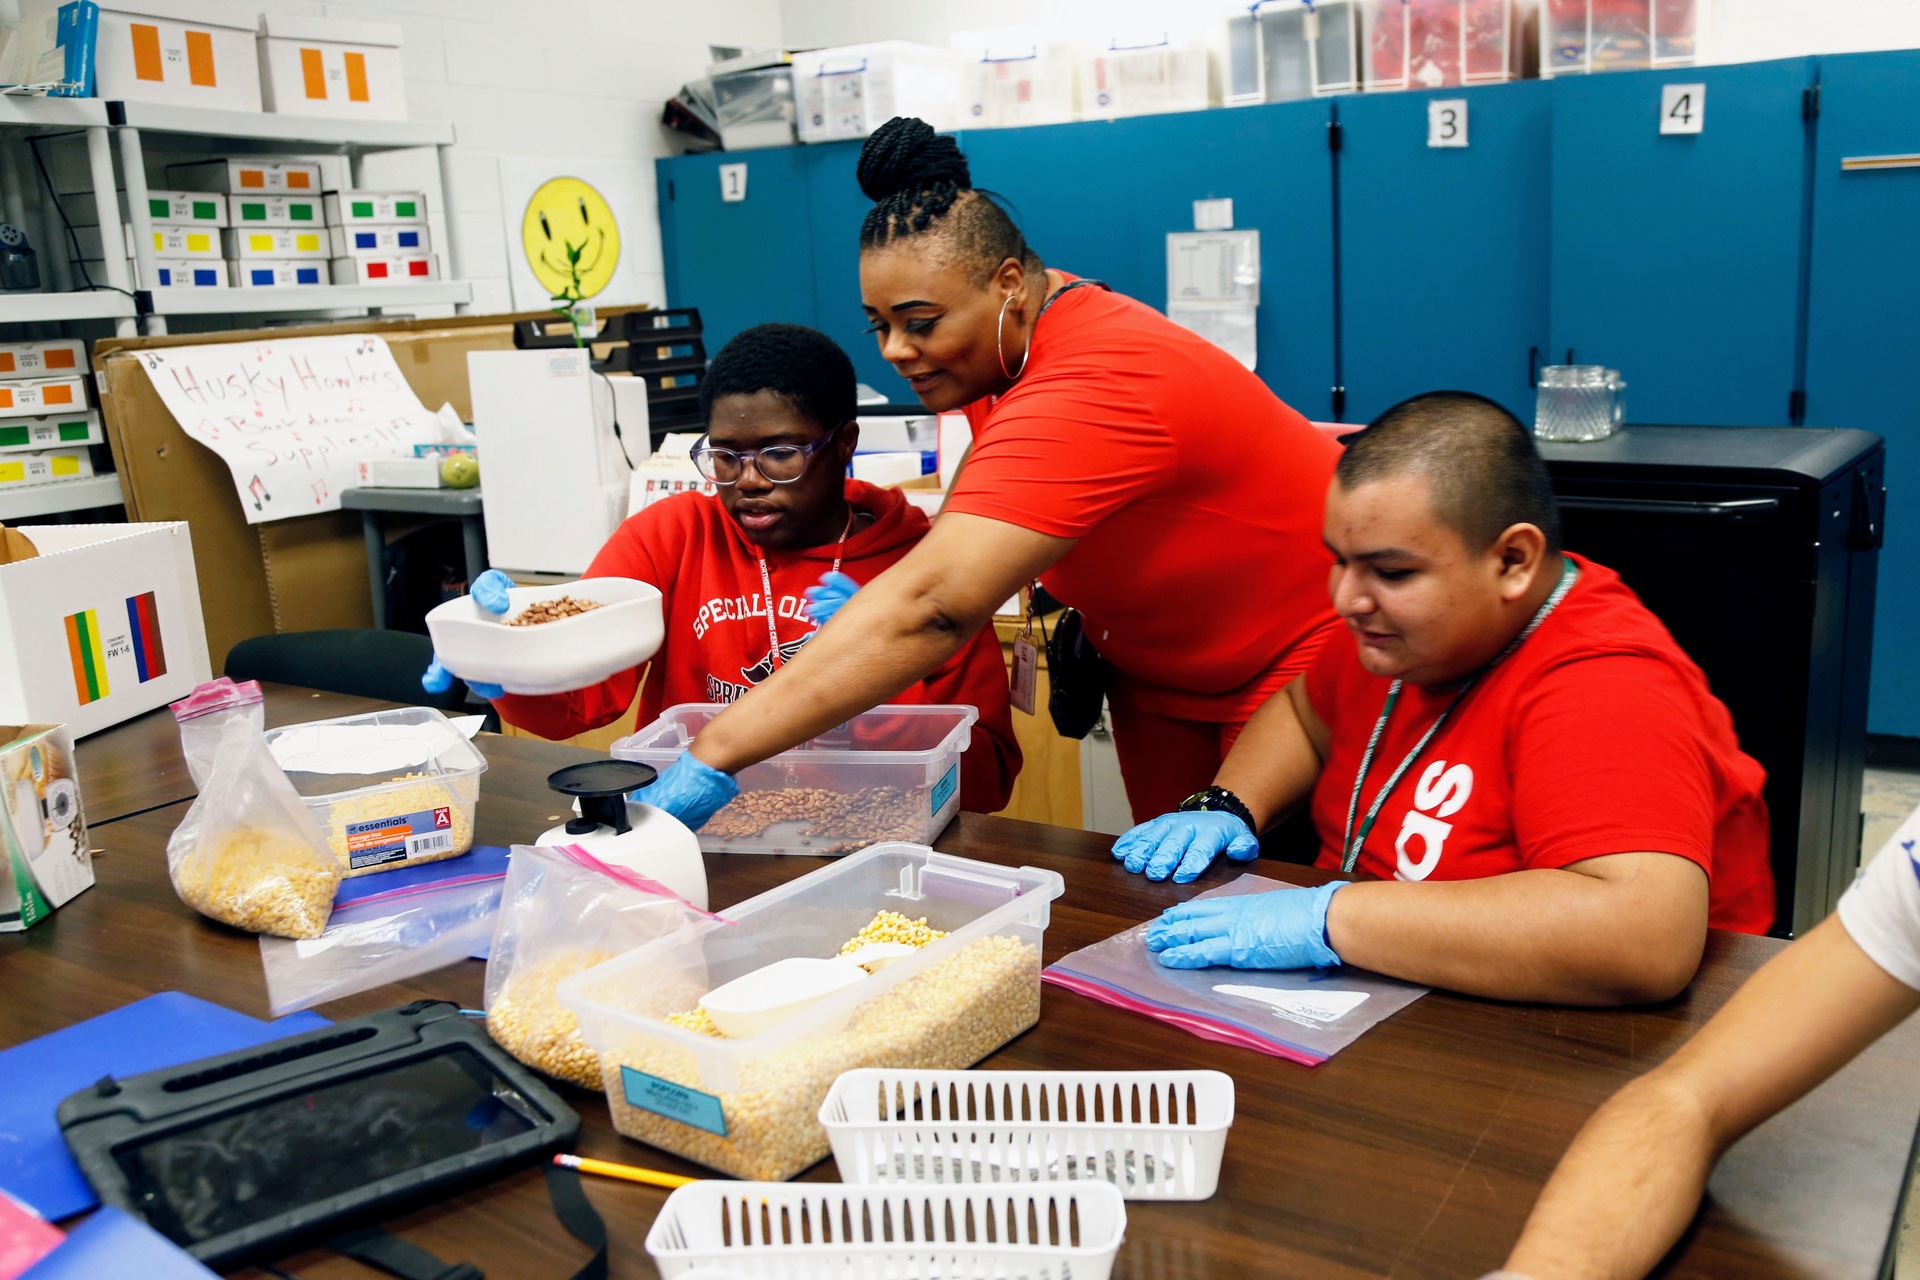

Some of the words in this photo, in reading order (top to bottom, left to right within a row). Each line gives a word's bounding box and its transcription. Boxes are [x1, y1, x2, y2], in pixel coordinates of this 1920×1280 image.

[1440, 109, 1457, 139] 3
[1670, 93, 1694, 125] 4
[728, 171, 739, 195] 1
[170, 363, 290, 412] Husky
[290, 354, 402, 394] Howlers
[759, 559, 772, 597] NORTHSIDE
[693, 593, 767, 640] SPECIAL
[778, 595, 818, 627] OL
[765, 596, 776, 632] LEARNING
[107, 649, 119, 659] FW
[120, 644, 130, 655] 1-6
[769, 631, 780, 658] CENTER
[358, 817, 408, 832] essentials
[436, 813, 450, 826] A
[1393, 760, 1474, 882] as
